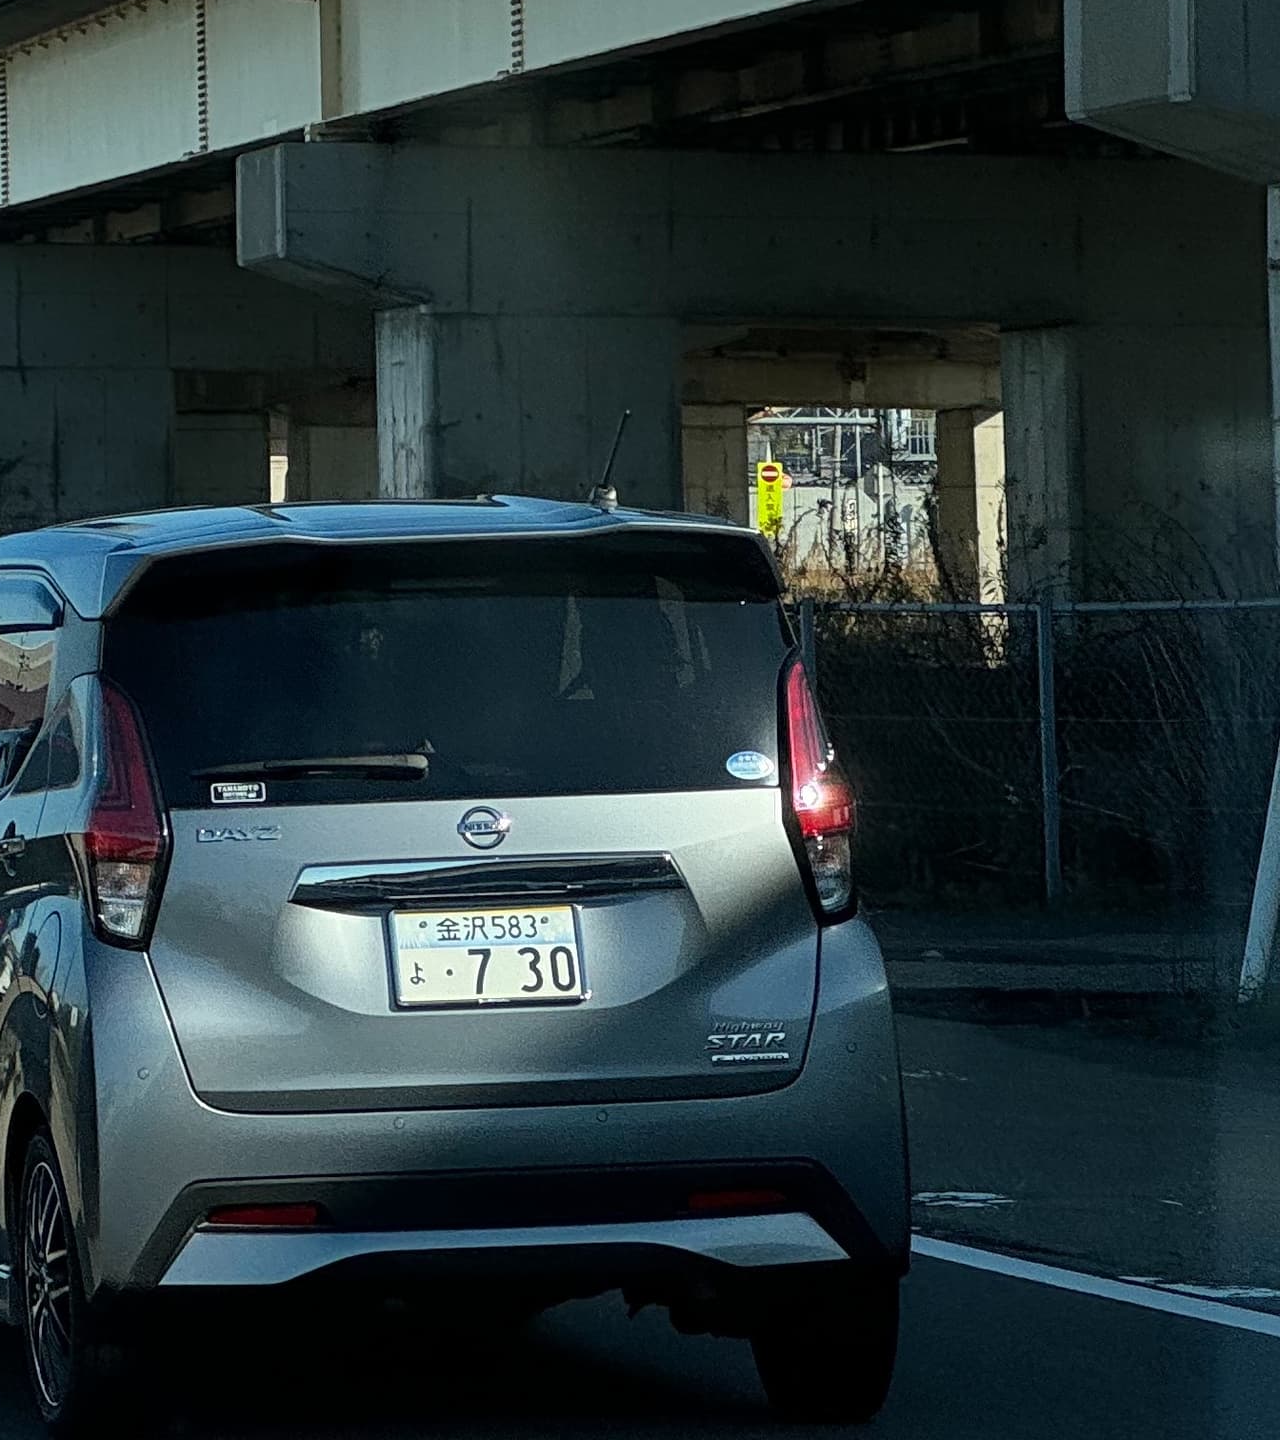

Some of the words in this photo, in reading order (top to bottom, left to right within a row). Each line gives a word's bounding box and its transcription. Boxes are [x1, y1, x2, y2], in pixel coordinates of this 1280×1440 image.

[435, 914, 538, 942] 金沢583
[409, 962, 426, 985] よ
[703, 1032, 786, 1050] STAR
